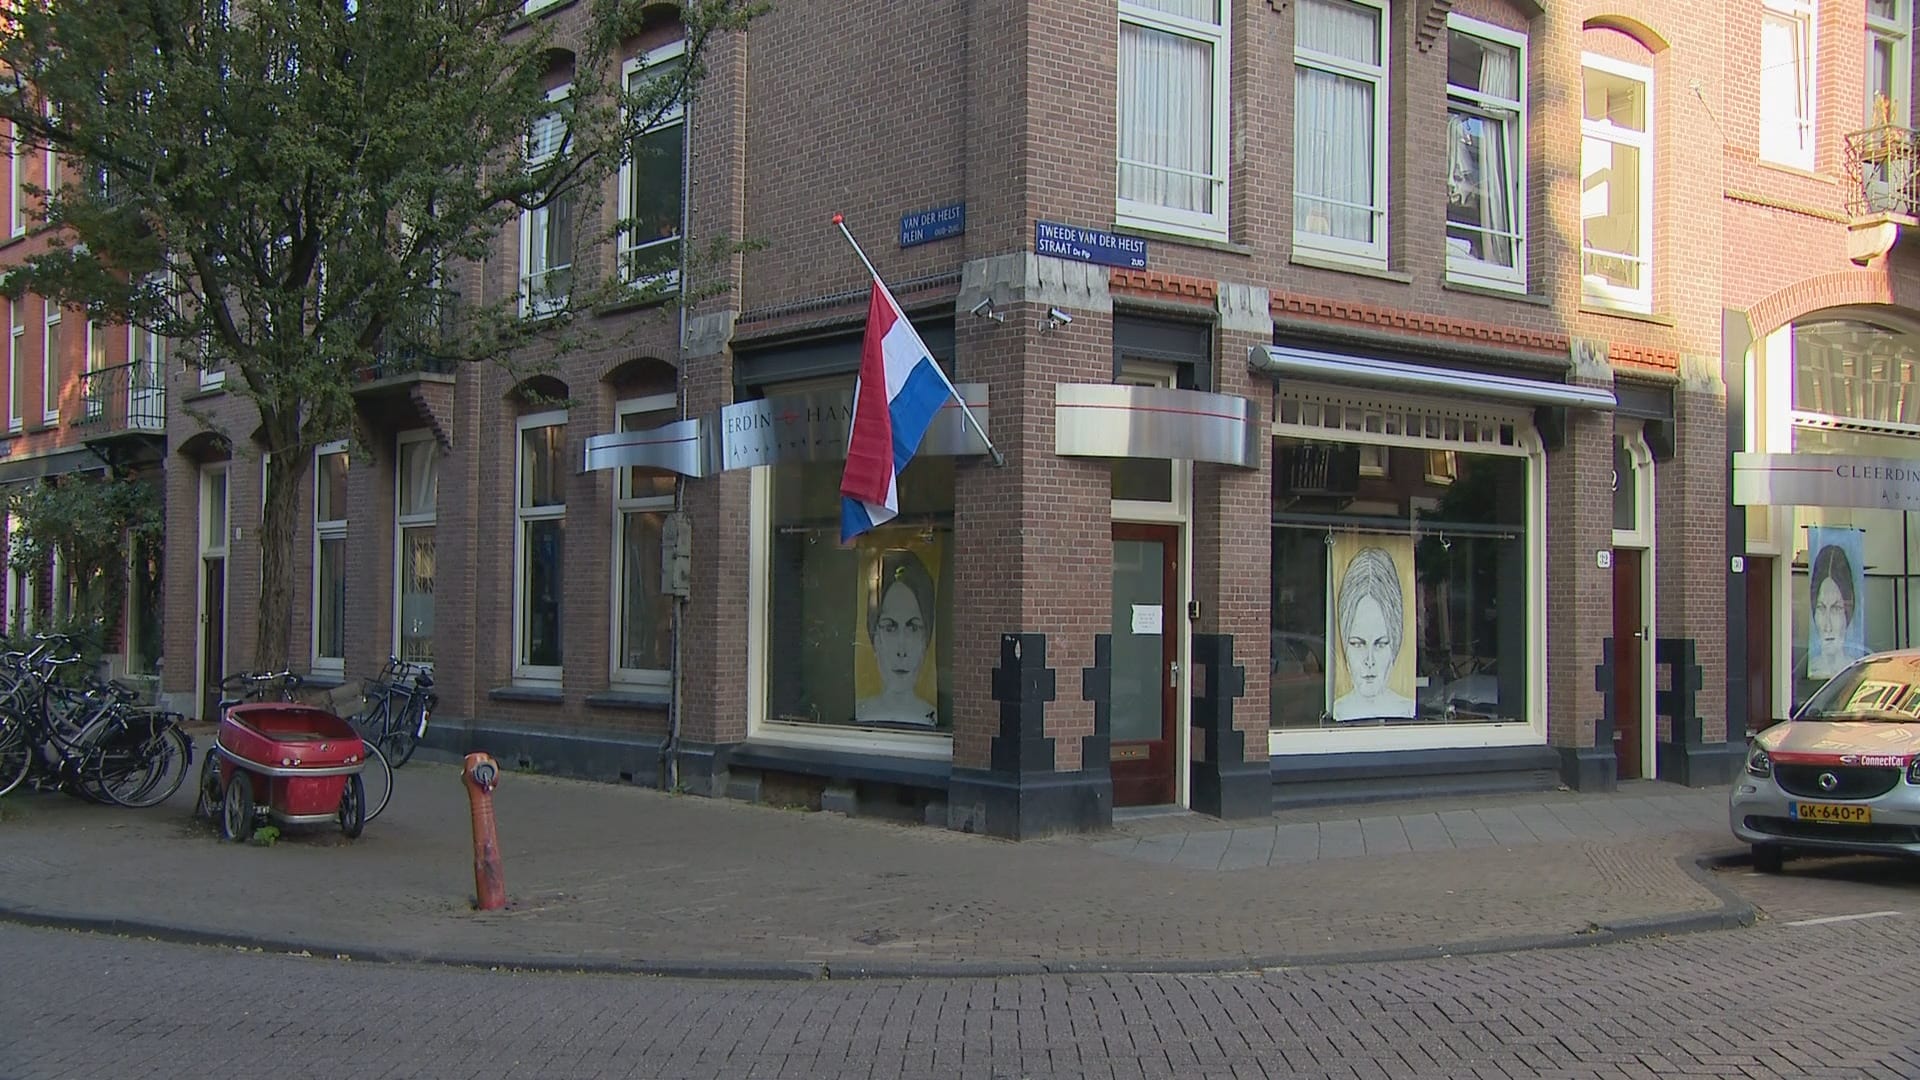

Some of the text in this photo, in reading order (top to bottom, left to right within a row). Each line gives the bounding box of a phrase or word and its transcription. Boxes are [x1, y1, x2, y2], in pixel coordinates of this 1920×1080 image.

[903, 206, 960, 230] VAN DER HELST
[903, 229, 924, 244] PLEIN
[1040, 225, 1145, 254] TWEEDE VAN DER HELST
[1040, 238, 1072, 256] STRAAT
[1836, 465, 1920, 482] CLEERDIN
[1860, 755, 1905, 767] ConnectCar
[1800, 804, 1866, 820] GK-640-P
